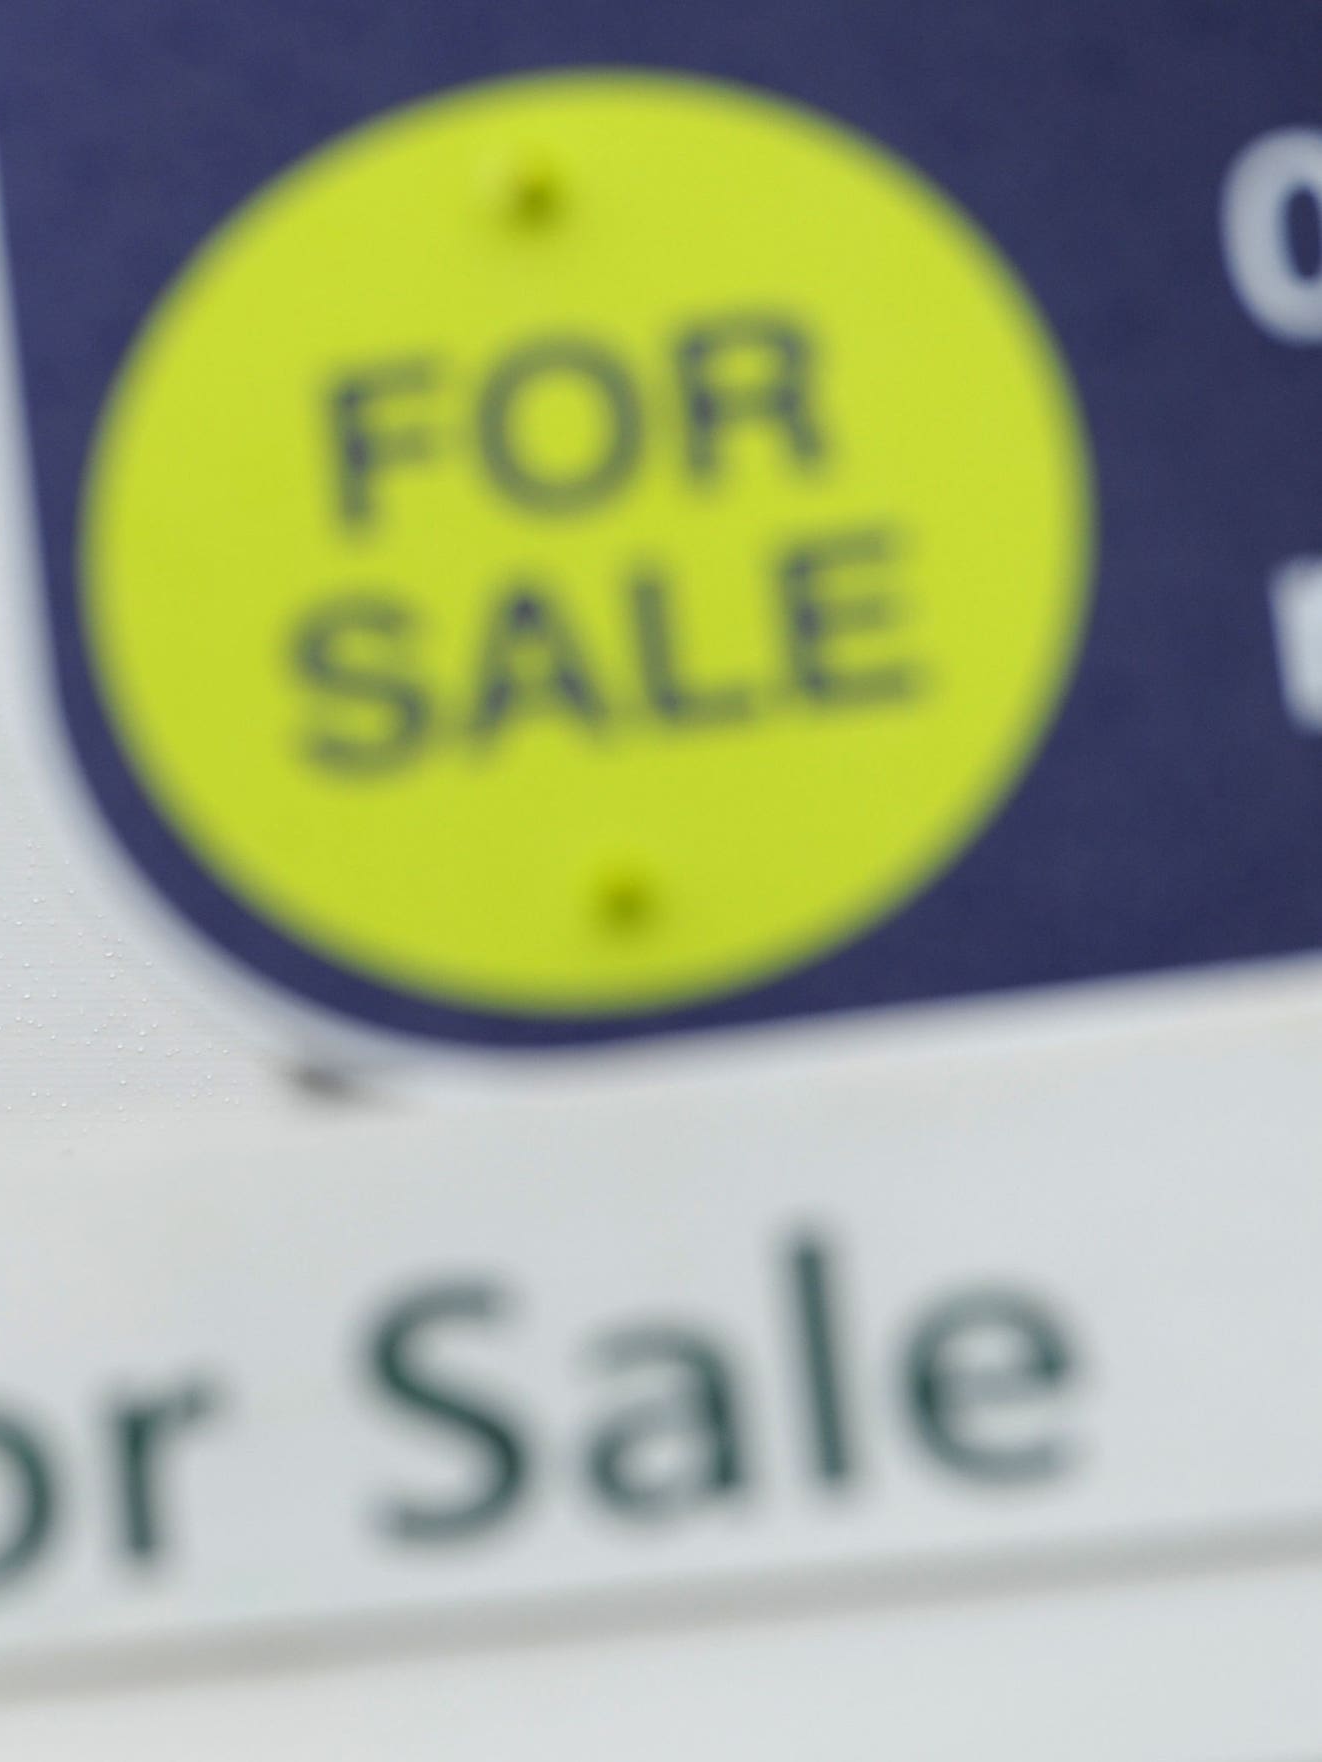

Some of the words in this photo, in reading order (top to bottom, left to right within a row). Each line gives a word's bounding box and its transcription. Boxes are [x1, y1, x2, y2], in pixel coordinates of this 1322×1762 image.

[326, 308, 827, 532] FOR
[285, 524, 930, 778] SALE
[353, 1222, 1088, 1550] Sale
